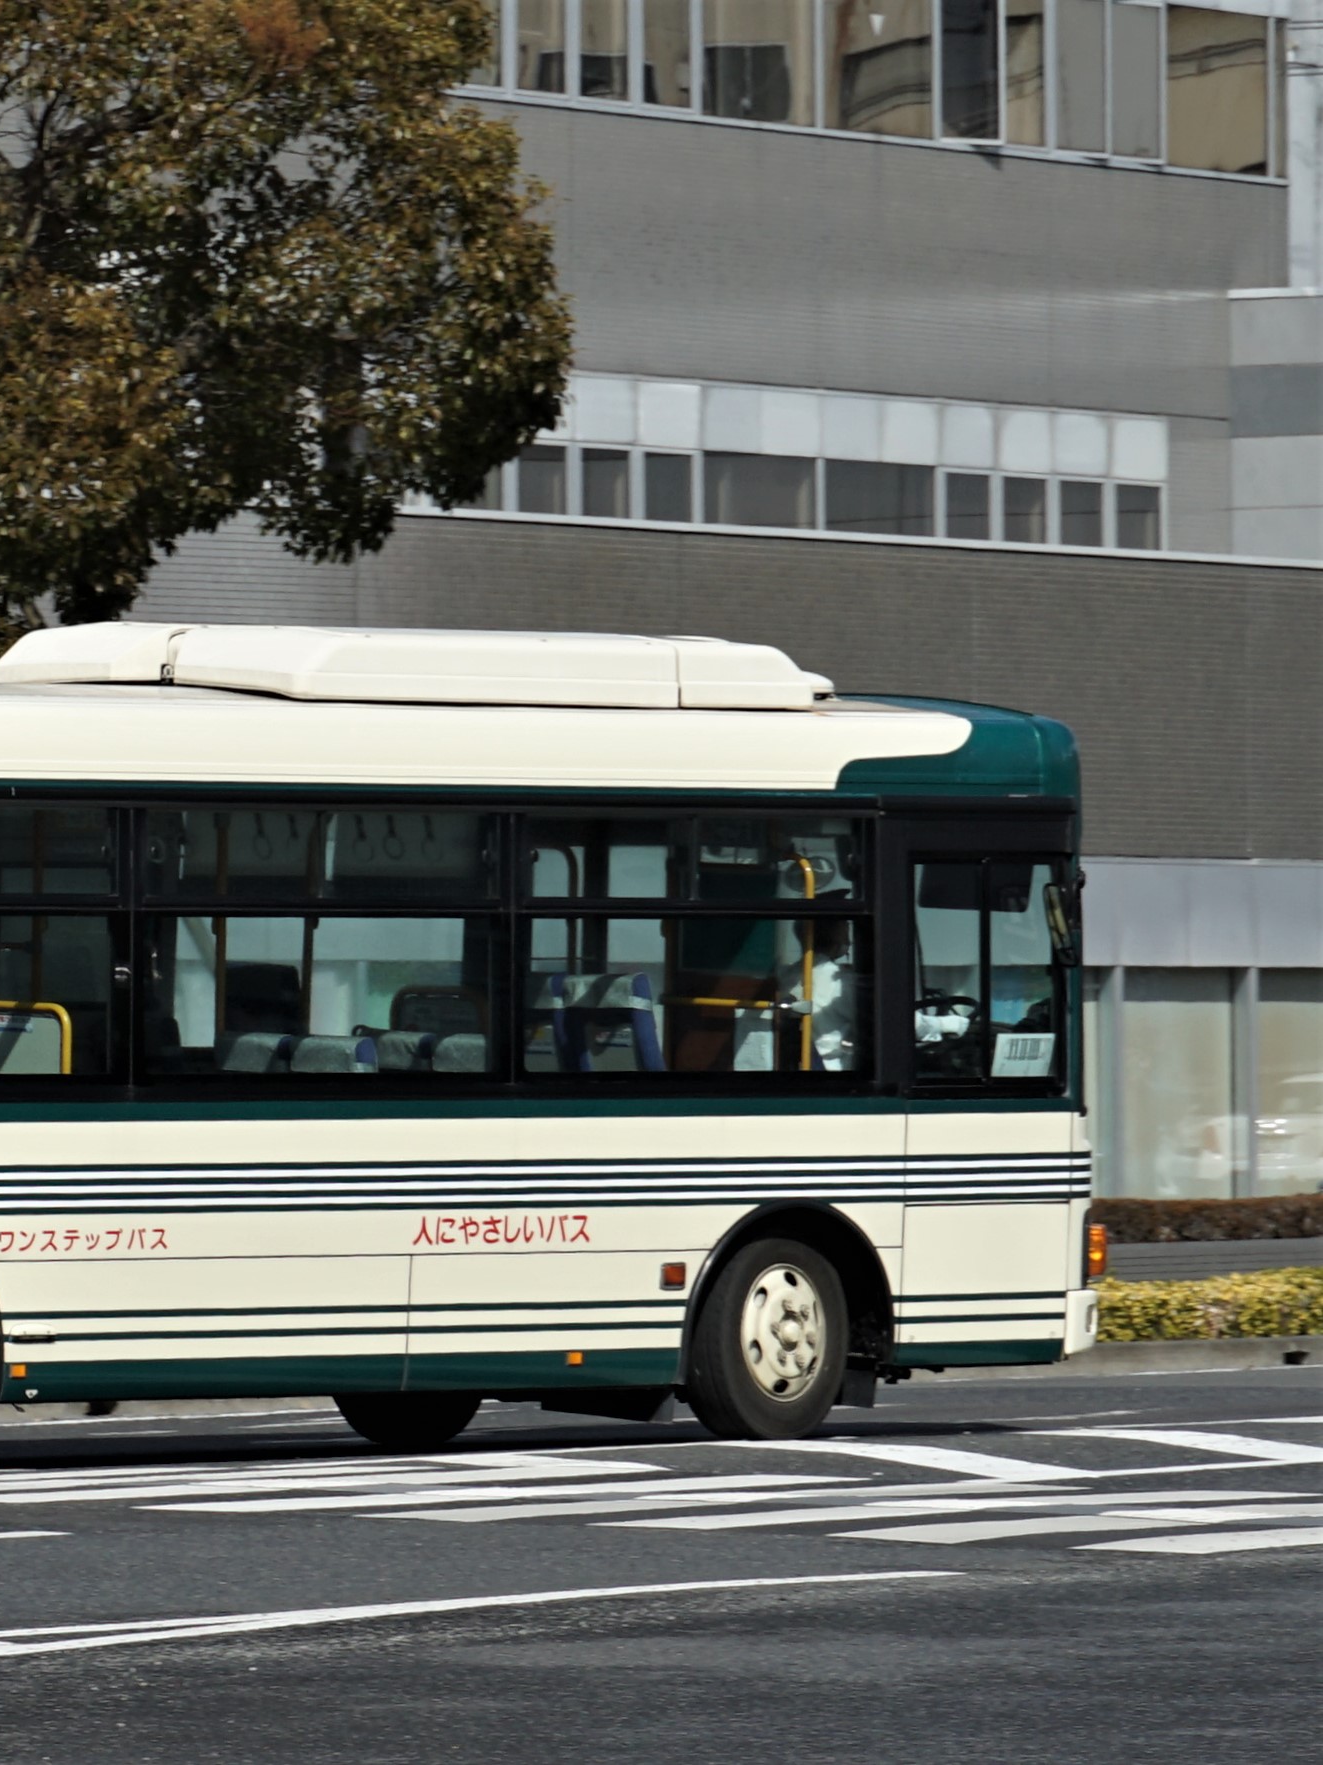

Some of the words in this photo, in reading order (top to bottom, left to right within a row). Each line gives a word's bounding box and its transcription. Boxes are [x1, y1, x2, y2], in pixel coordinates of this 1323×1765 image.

[412, 1214, 590, 1245] 人にやさしいバス
